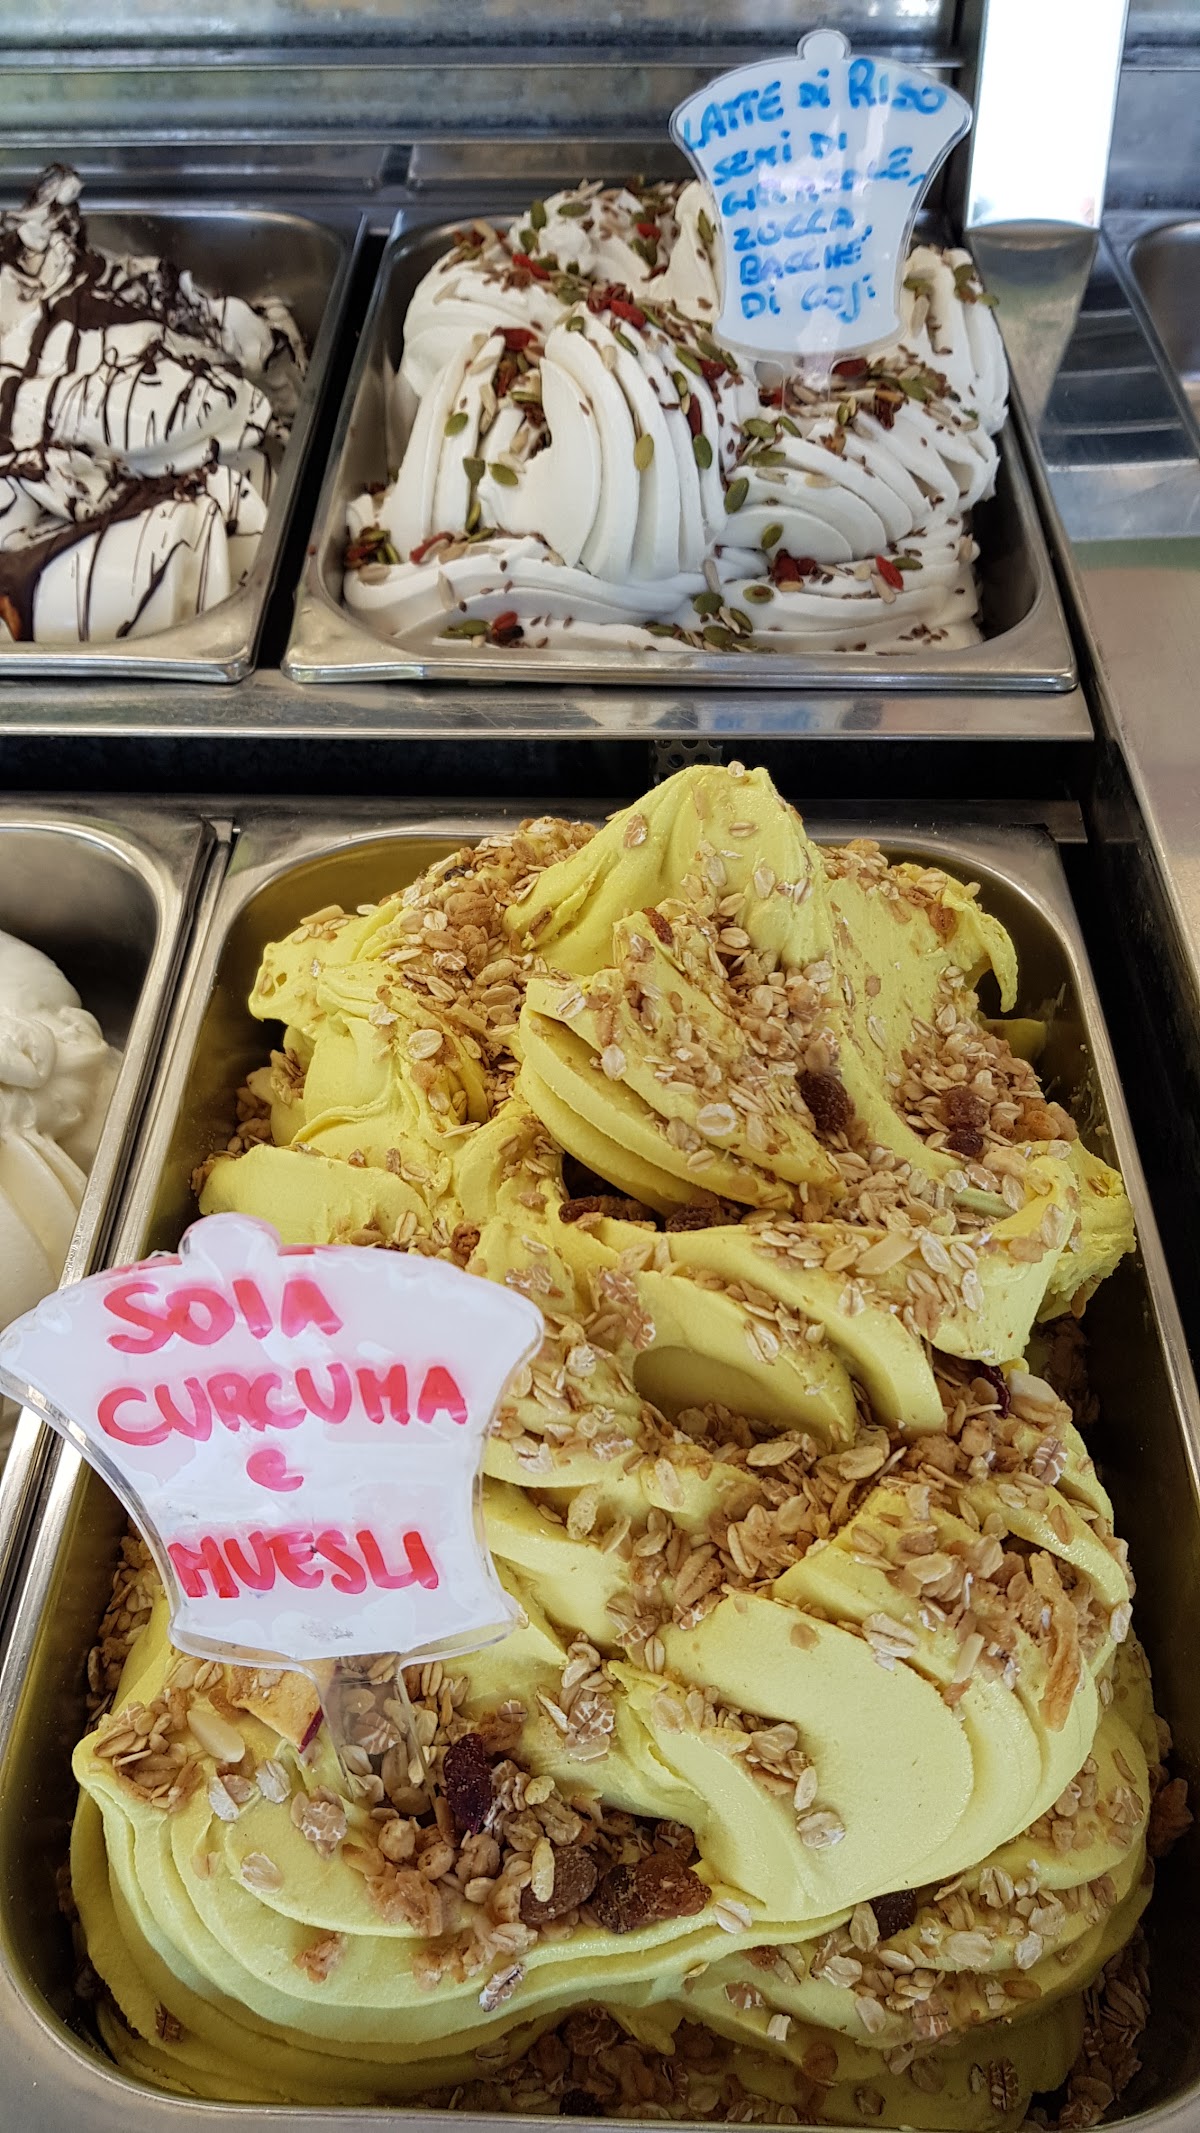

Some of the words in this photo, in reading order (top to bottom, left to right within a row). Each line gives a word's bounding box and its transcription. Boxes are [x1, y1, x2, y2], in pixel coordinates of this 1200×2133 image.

[683, 80, 784, 150] LATTE
[848, 58, 948, 115] RISO
[103, 1278, 343, 1354] SOIA
[97, 1362, 469, 1446] CURCUMA
[168, 1529, 439, 1599] MUESLI
